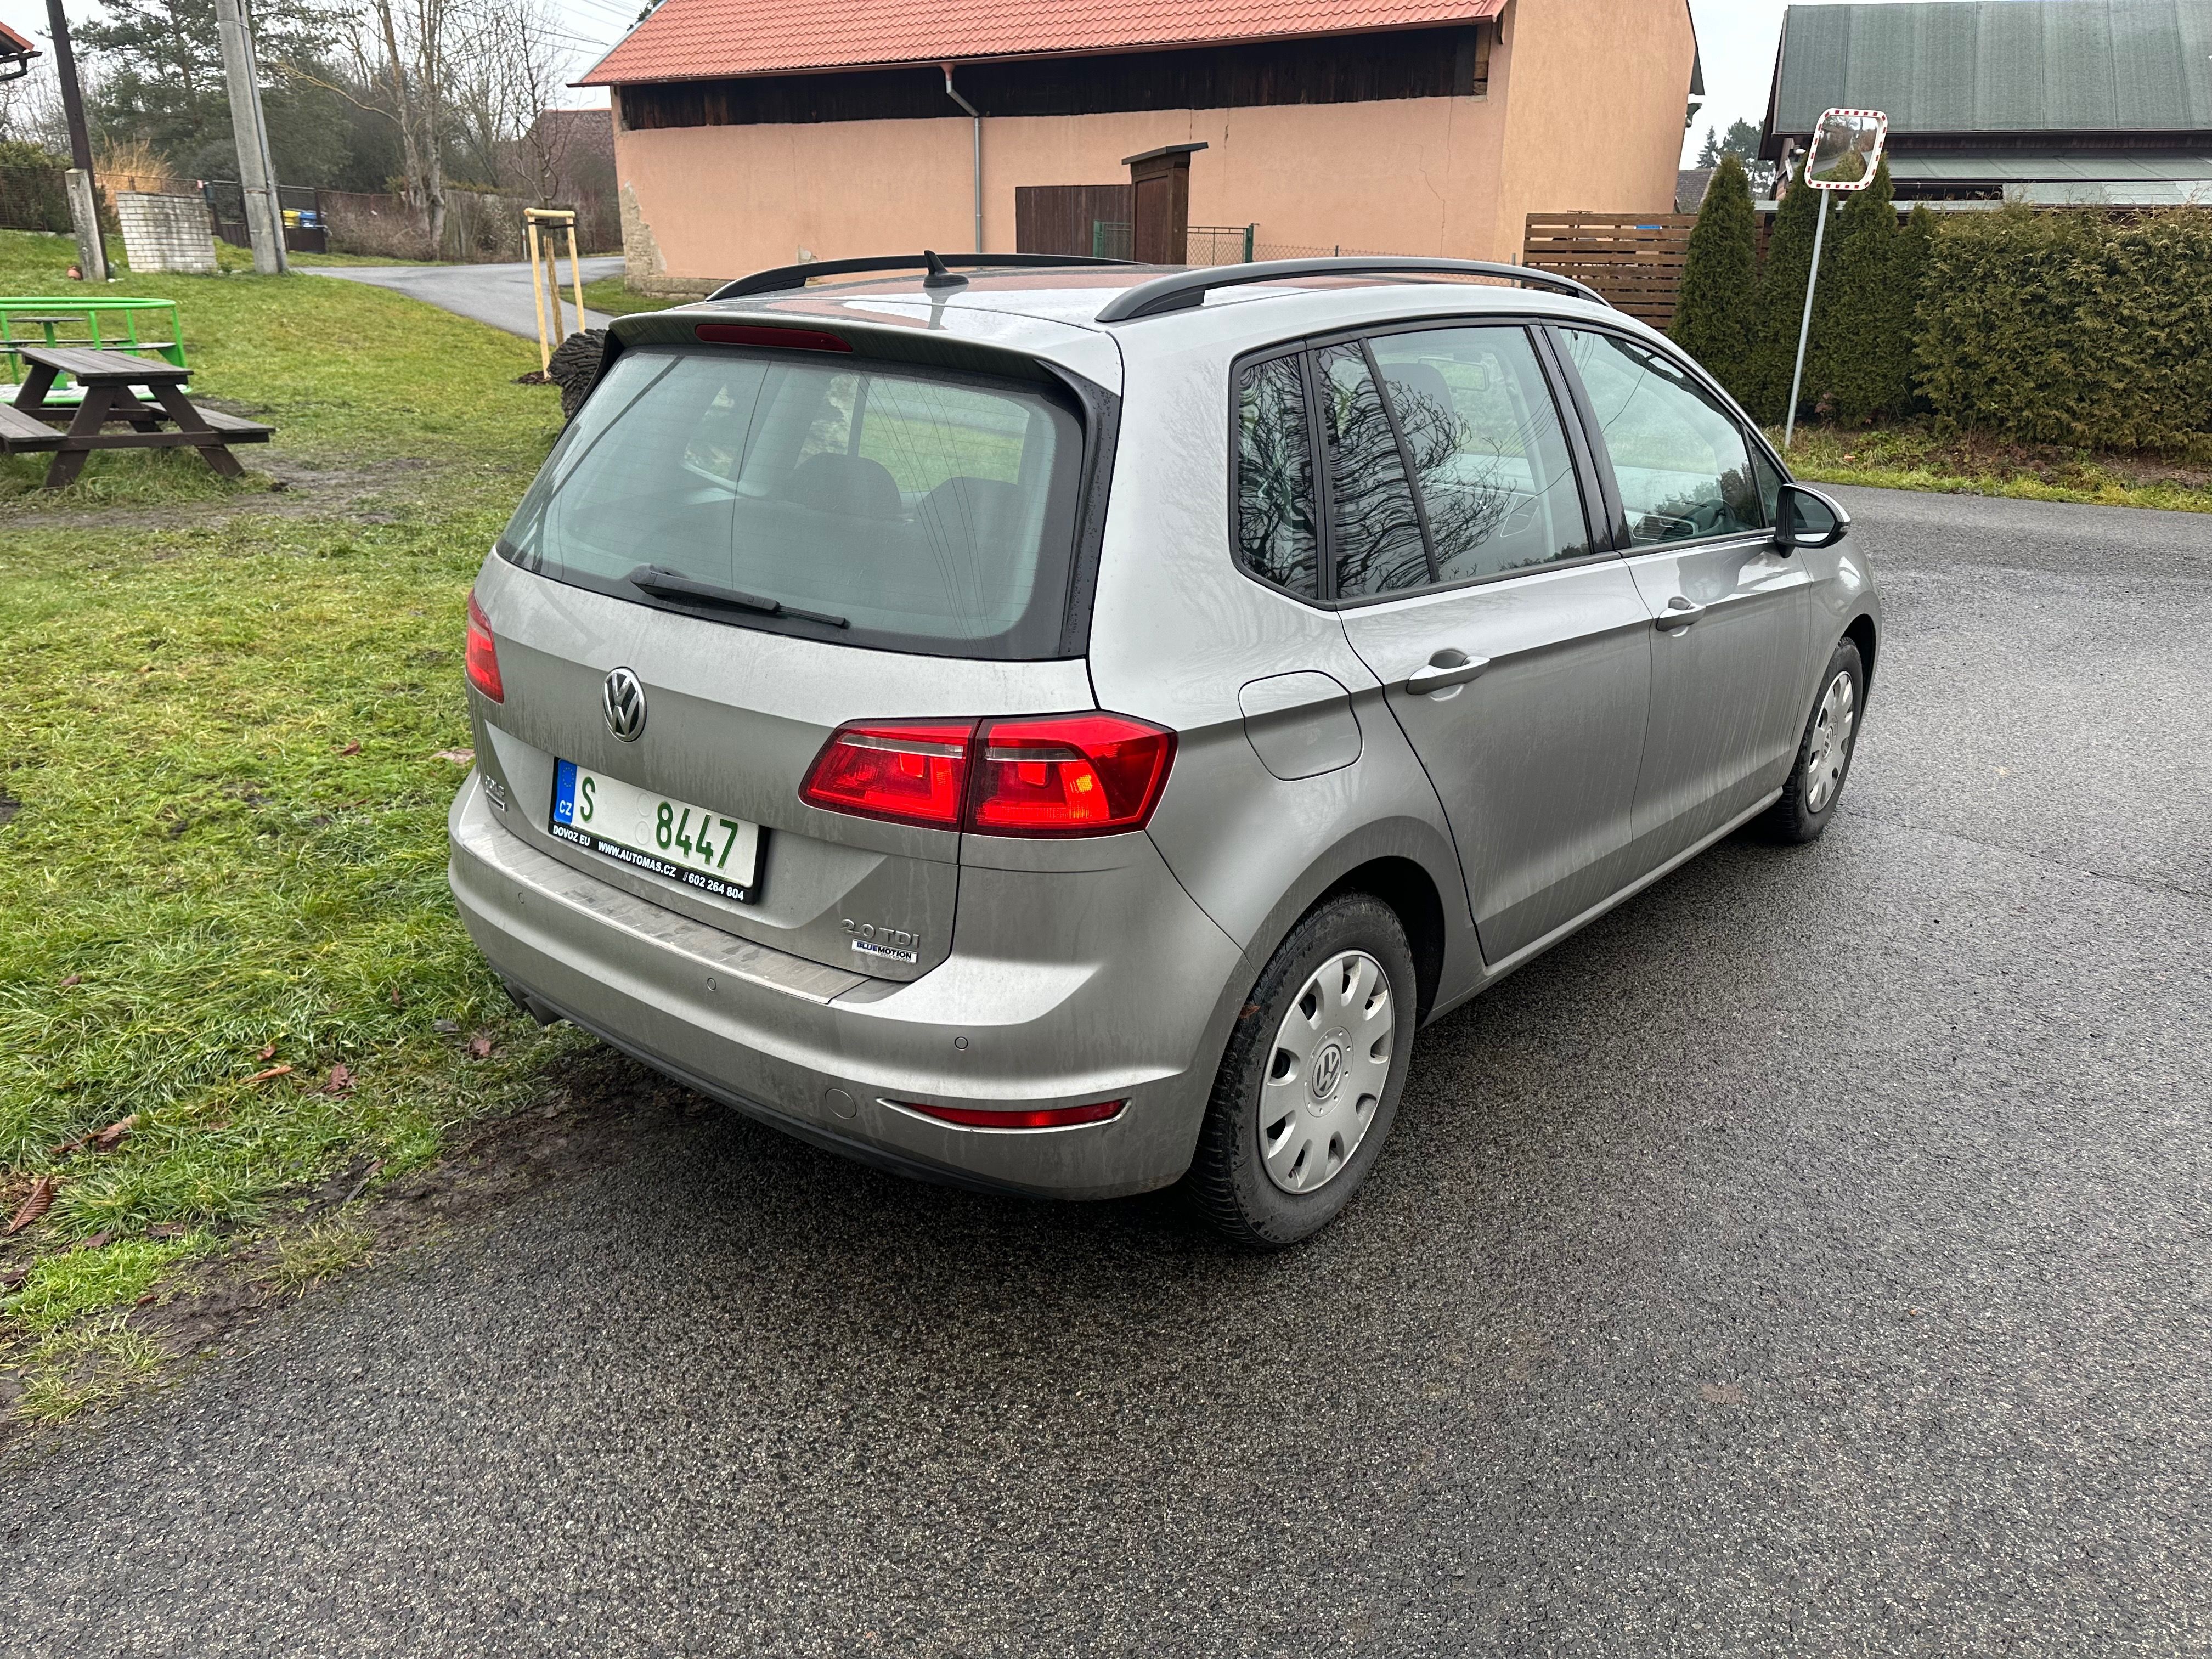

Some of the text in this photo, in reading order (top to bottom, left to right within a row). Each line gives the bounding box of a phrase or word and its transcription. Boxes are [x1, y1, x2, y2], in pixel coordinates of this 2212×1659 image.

[560, 800, 572, 816] CZ
[580, 777, 738, 869] S 8447
[553, 825, 744, 901] DOVOZ EU WWW.AUTOMAS.CZ 602 264 804
[879, 927, 920, 949] TDI
[856, 940, 912, 959] BLUEMOTION
